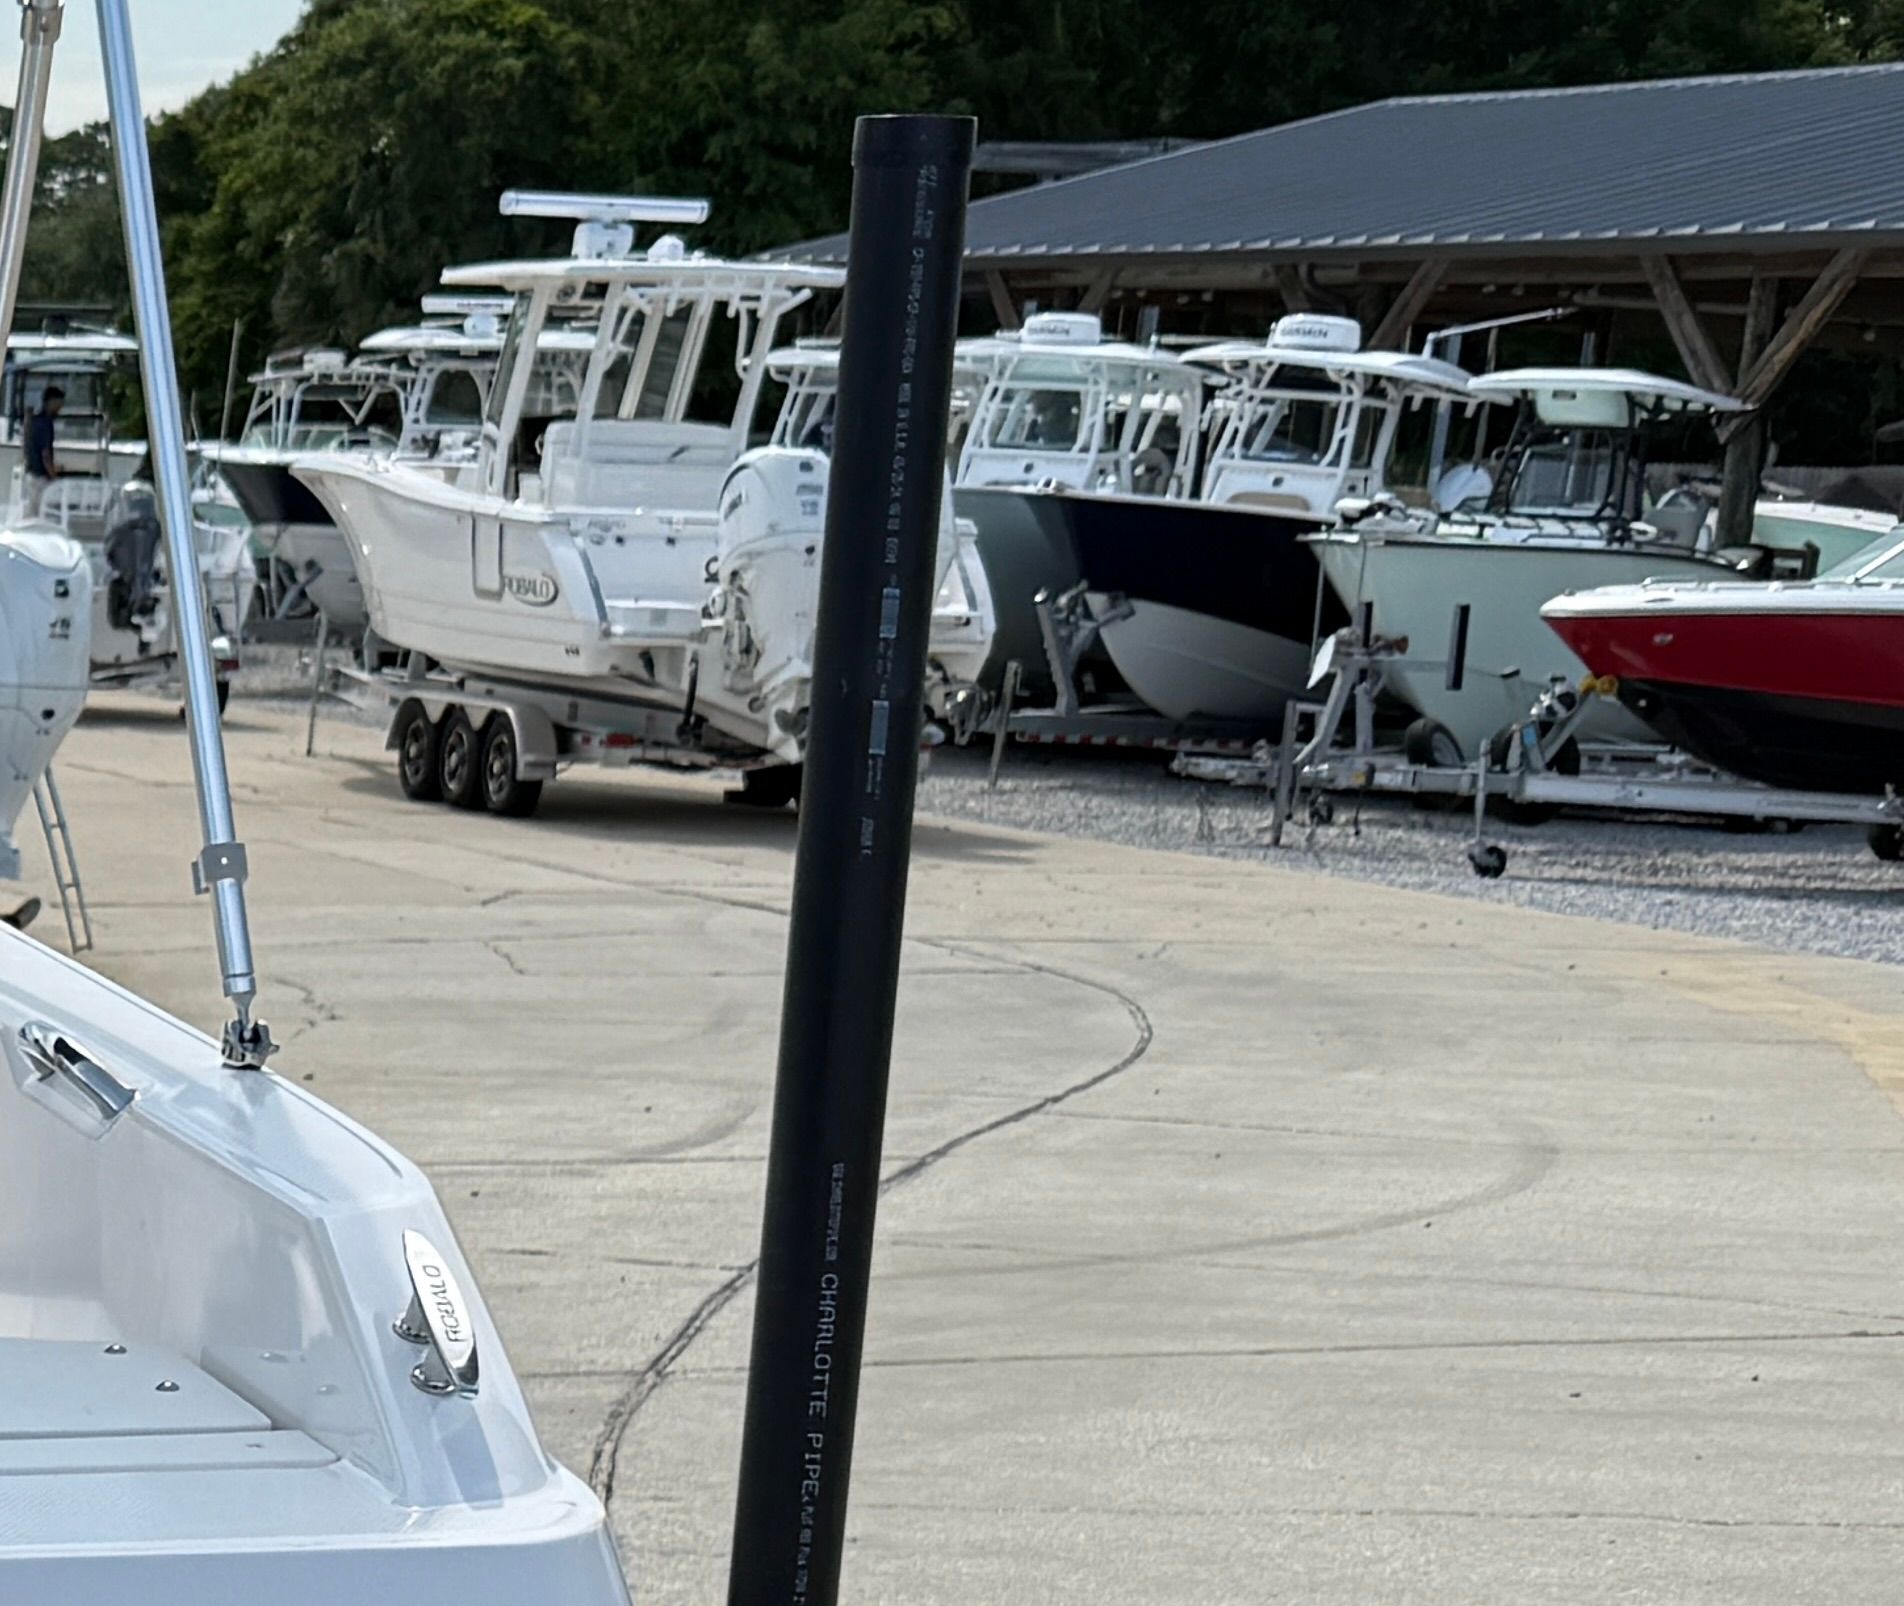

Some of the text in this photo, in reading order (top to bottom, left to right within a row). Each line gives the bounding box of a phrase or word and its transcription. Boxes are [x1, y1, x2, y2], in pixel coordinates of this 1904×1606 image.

[422, 1264, 466, 1342] ROBALO
[808, 1273, 839, 1418] CHARLOTTE
[801, 1432, 824, 1497] PIPE
